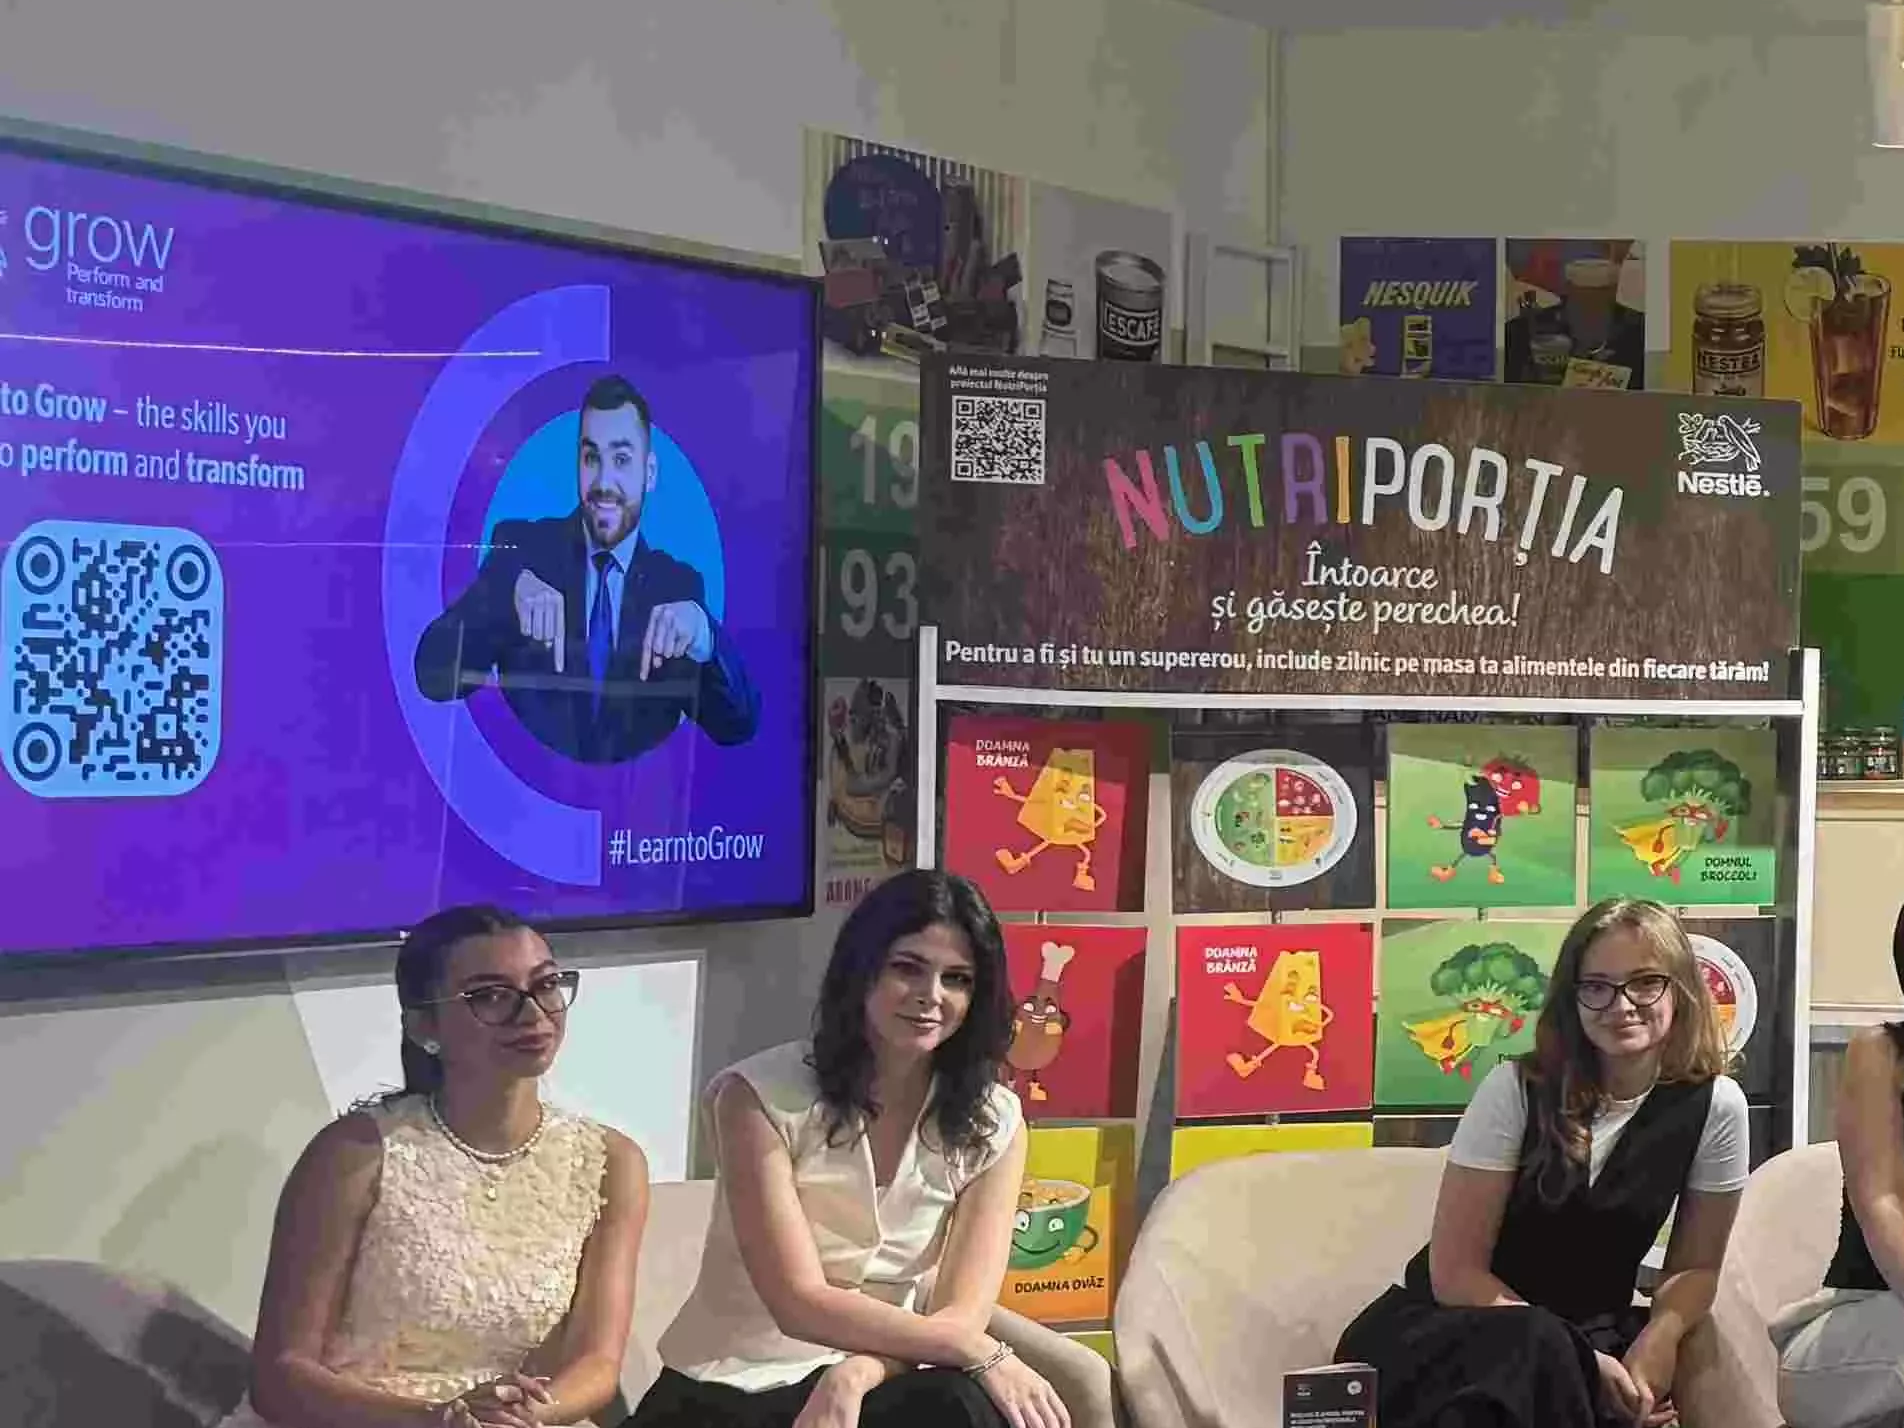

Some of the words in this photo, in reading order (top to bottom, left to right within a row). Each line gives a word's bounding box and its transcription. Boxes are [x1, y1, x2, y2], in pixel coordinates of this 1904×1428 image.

[25, 205, 174, 270] grow
[66, 262, 130, 288] Perform
[135, 276, 164, 293] and
[1363, 279, 1478, 310] NESQUIK
[66, 286, 144, 312] transform
[1, 382, 29, 416] to
[35, 383, 107, 422] Grow
[136, 395, 175, 429] the
[181, 400, 240, 436] skills
[244, 414, 287, 445] you
[21, 438, 128, 477] perform
[134, 449, 181, 481] and
[185, 452, 305, 491] transform
[1103, 432, 1624, 574] NUTRIPORȚIA
[1301, 541, 1438, 589] Întoarce
[1211, 591, 1237, 630] și
[1246, 590, 1367, 633] găsește
[1372, 592, 1521, 635] perechea!
[945, 640, 1018, 663] Pentru
[1023, 649, 1034, 664] a
[1039, 642, 1055, 664] fi
[1060, 646, 1077, 670] și
[1083, 647, 1103, 666] tu
[1109, 652, 1134, 667] un
[1140, 650, 1252, 672] supererou,
[1256, 649, 1332, 671] include
[1337, 652, 1391, 673] zilnic
[1395, 660, 1420, 678] pe
[1424, 658, 1475, 675] masa
[1480, 658, 1499, 675] ta
[1502, 654, 1605, 678] alimentele
[1609, 657, 1640, 678] din
[1643, 658, 1706, 680] fiecare
[976, 739, 1030, 752] DOAMNA
[609, 825, 765, 866] #LearntoGrow
[1704, 856, 1752, 868] DOMNUL
[1700, 869, 1757, 882] BROCCOLI
[1205, 946, 1258, 959] DOAMNA
[1015, 1278, 1070, 1294] DOAMNA
